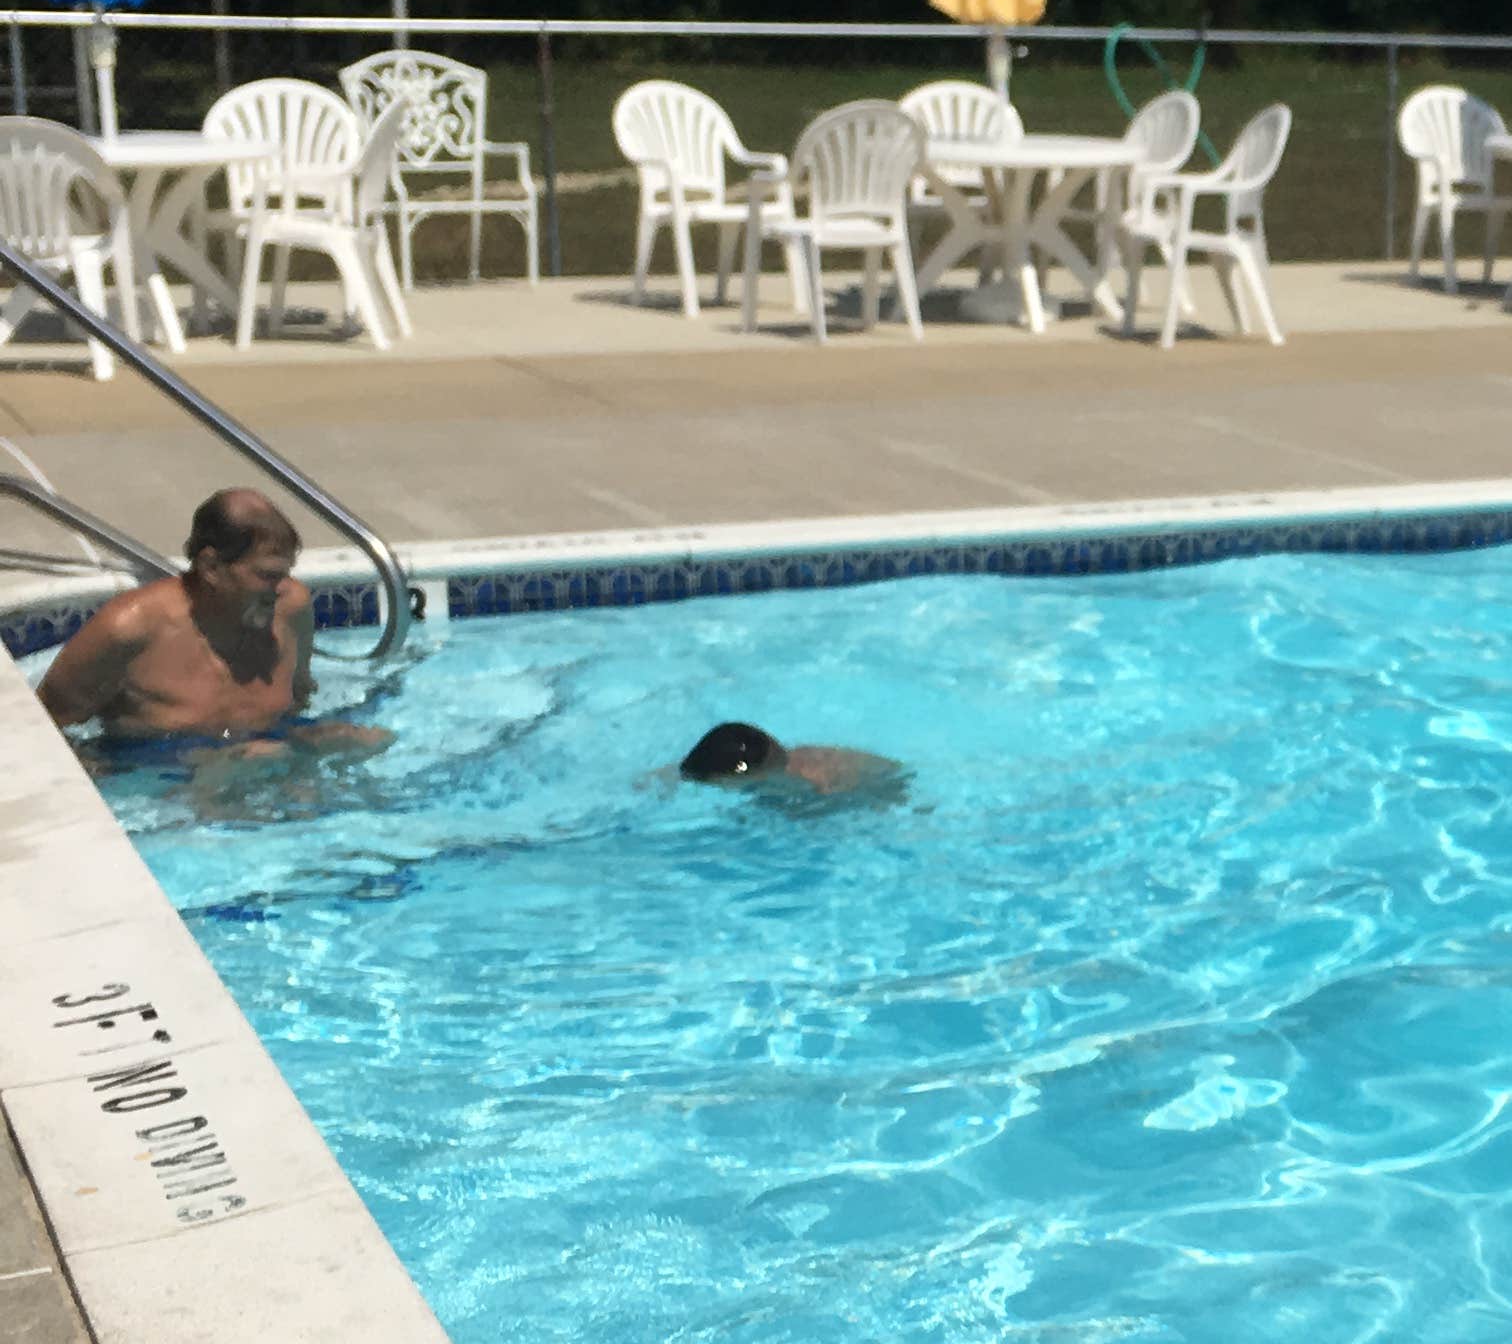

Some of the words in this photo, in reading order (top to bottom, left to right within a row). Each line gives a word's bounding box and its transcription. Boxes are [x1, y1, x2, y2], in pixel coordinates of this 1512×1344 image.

[52, 983, 131, 1008] 3
[53, 1002, 171, 1056] FT
[87, 1060, 189, 1113] NO
